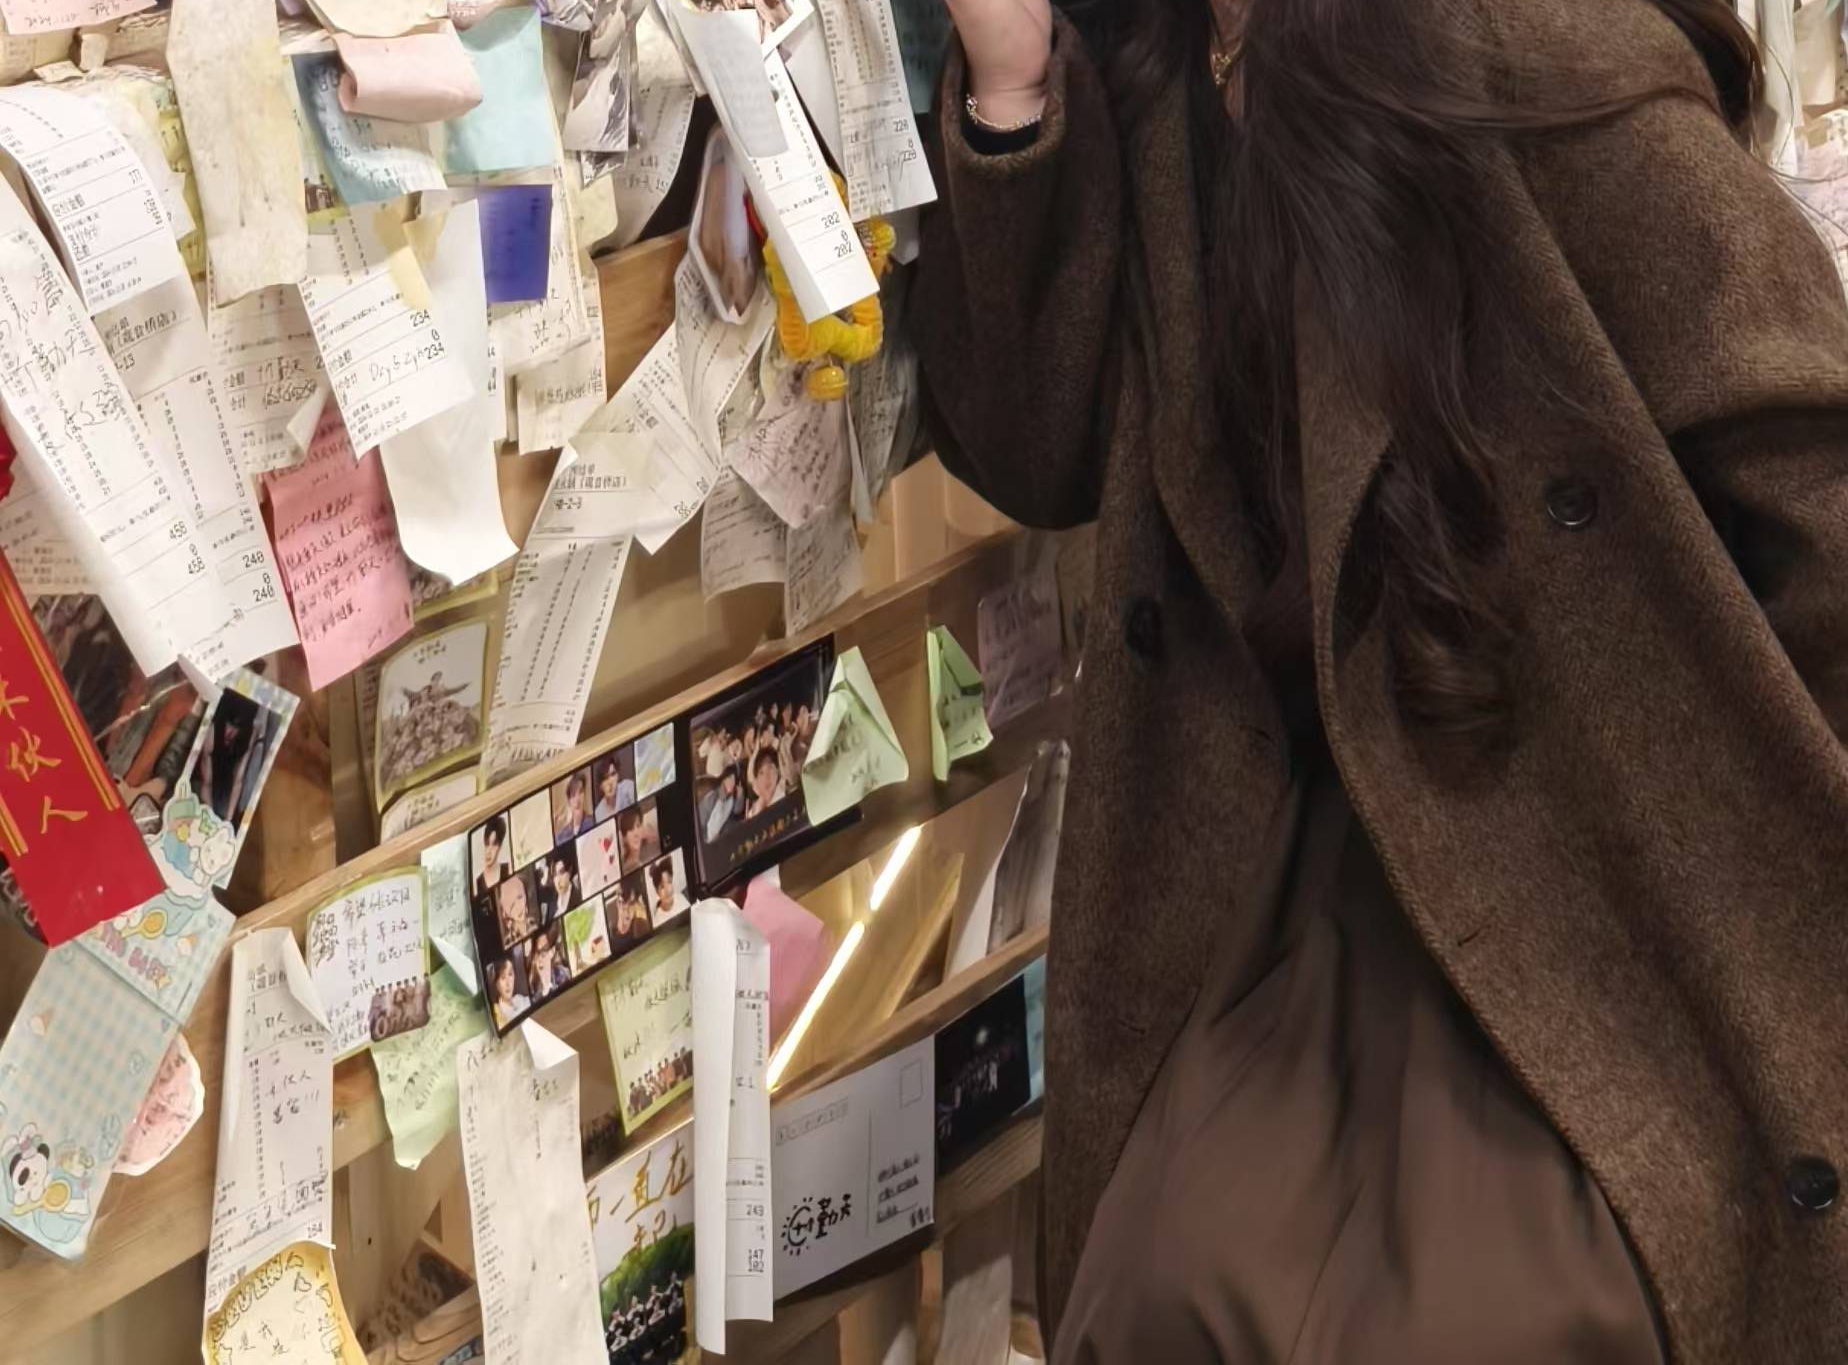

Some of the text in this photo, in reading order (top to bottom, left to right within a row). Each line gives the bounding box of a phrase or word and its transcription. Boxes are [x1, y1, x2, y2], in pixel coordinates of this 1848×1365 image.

[409, 308, 432, 329] 234
[423, 341, 446, 361] 234
[242, 550, 266, 569] 240
[262, 572, 272, 586] 0
[252, 584, 276, 603] 240
